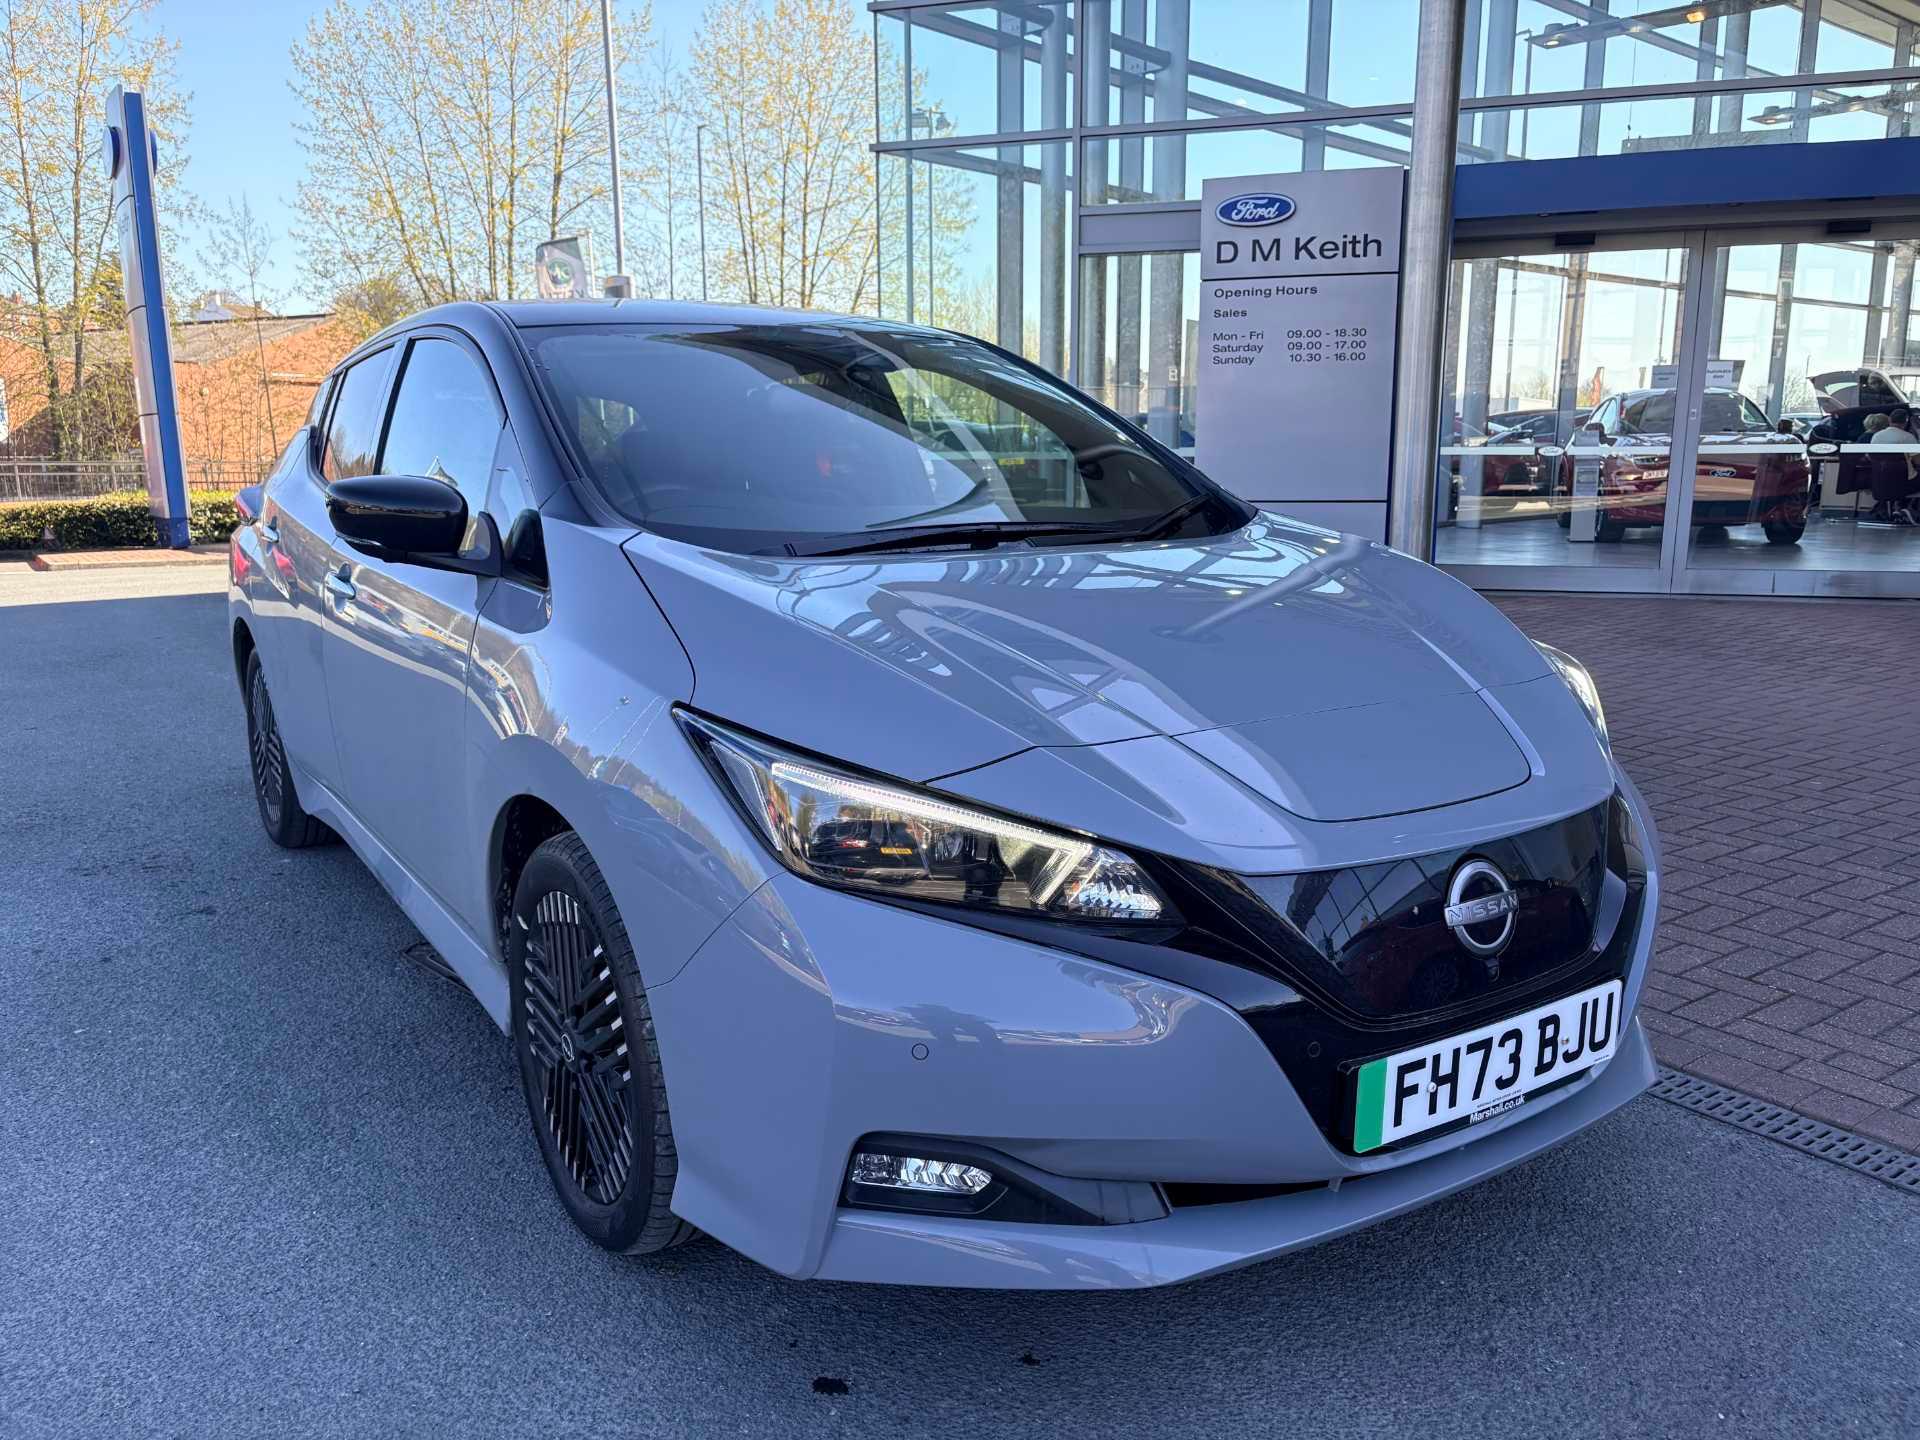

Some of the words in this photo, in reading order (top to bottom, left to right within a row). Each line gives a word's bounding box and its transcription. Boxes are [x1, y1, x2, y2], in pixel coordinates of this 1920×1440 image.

[1231, 198, 1280, 221] Ford
[1216, 241, 1239, 264] D
[1251, 238, 1281, 262] M
[1294, 234, 1382, 261] Keith
[1214, 287, 1272, 299] Opening
[1276, 285, 1318, 296] Hours
[1213, 309, 1248, 318] Sales
[1213, 332, 1237, 341] Mon
[1249, 331, 1263, 340] Fri
[1287, 329, 1321, 339] 09.00
[1335, 328, 1367, 337] 18.30
[1212, 343, 1263, 354] Saturday
[1287, 341, 1321, 350] 09.00
[1335, 340, 1366, 349] 17.00
[1212, 355, 1255, 366] Sunday
[1290, 353, 1321, 362] 10.30
[1335, 352, 1366, 361] 16.00
[1447, 893, 1517, 924] NISSAN
[1393, 1027, 1523, 1128] FH73
[1534, 992, 1615, 1077] BJU
[1469, 1094, 1525, 1125] Marshall.co.uk
